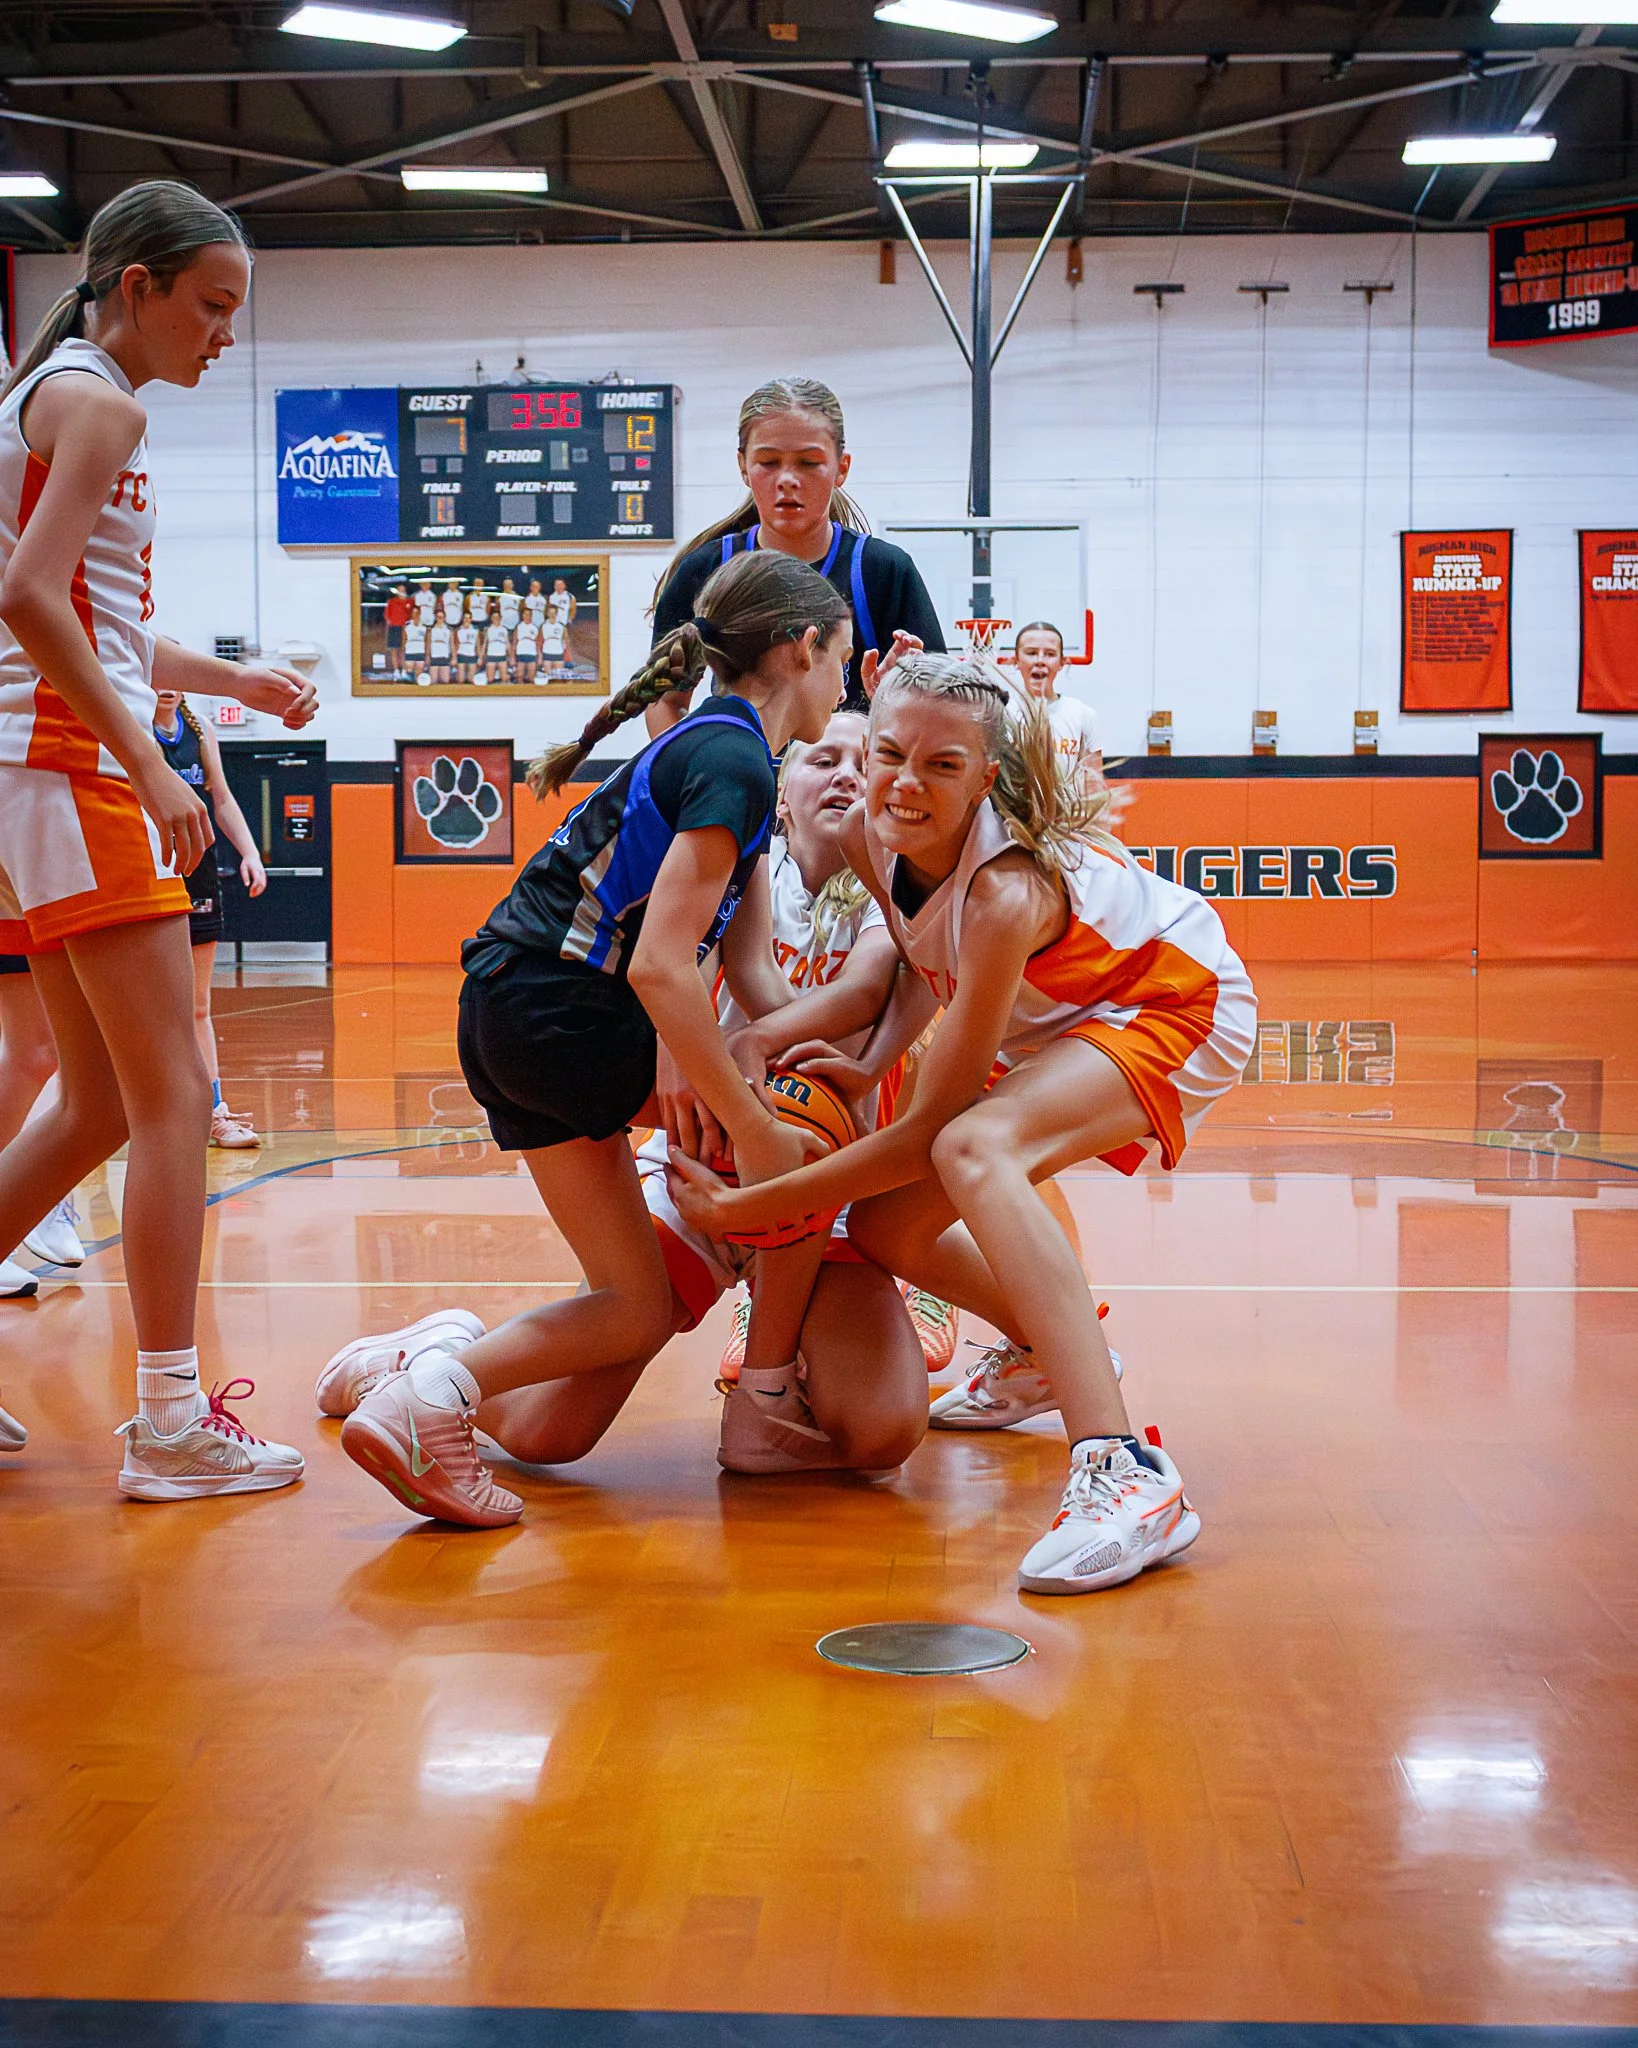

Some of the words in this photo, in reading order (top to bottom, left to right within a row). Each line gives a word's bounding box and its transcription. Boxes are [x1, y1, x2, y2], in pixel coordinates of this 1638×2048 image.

[1548, 299, 1600, 330] 1999
[408, 394, 473, 412] GUEST
[601, 392, 659, 409] HOME
[626, 415, 655, 451] 12
[485, 449, 542, 463] PERIOD
[278, 444, 399, 485] AQUAFINA
[422, 482, 462, 495] FOULS
[495, 481, 578, 493] PLAYER-FOUL
[611, 480, 651, 493] FOULS
[420, 525, 465, 538] POINTS
[496, 525, 541, 537] MATCH
[609, 524, 654, 536] POINTS
[1432, 563, 1483, 578] STATE
[1412, 576, 1502, 592] RUNNER-UP
[220, 706, 241, 723] EXIT
